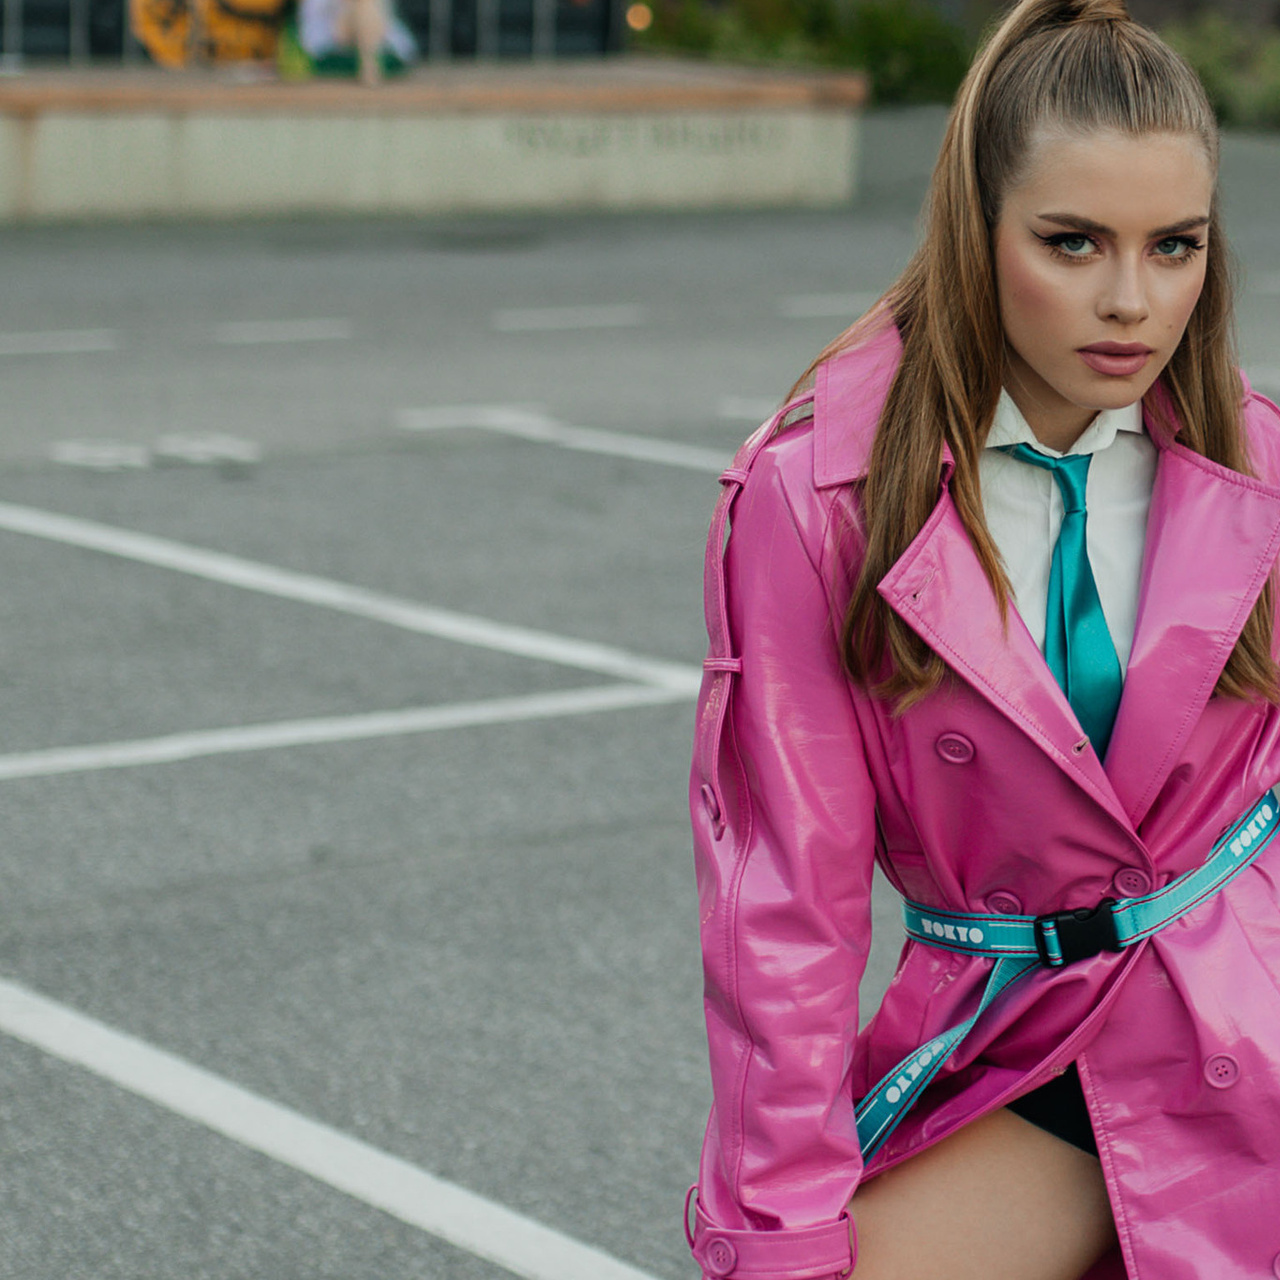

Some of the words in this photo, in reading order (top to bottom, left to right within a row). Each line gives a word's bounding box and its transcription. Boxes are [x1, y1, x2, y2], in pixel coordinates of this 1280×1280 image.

[1229, 804, 1273, 857] TOKYO
[921, 918, 984, 944] TOKYO
[885, 1041, 945, 1104] TOKYO
